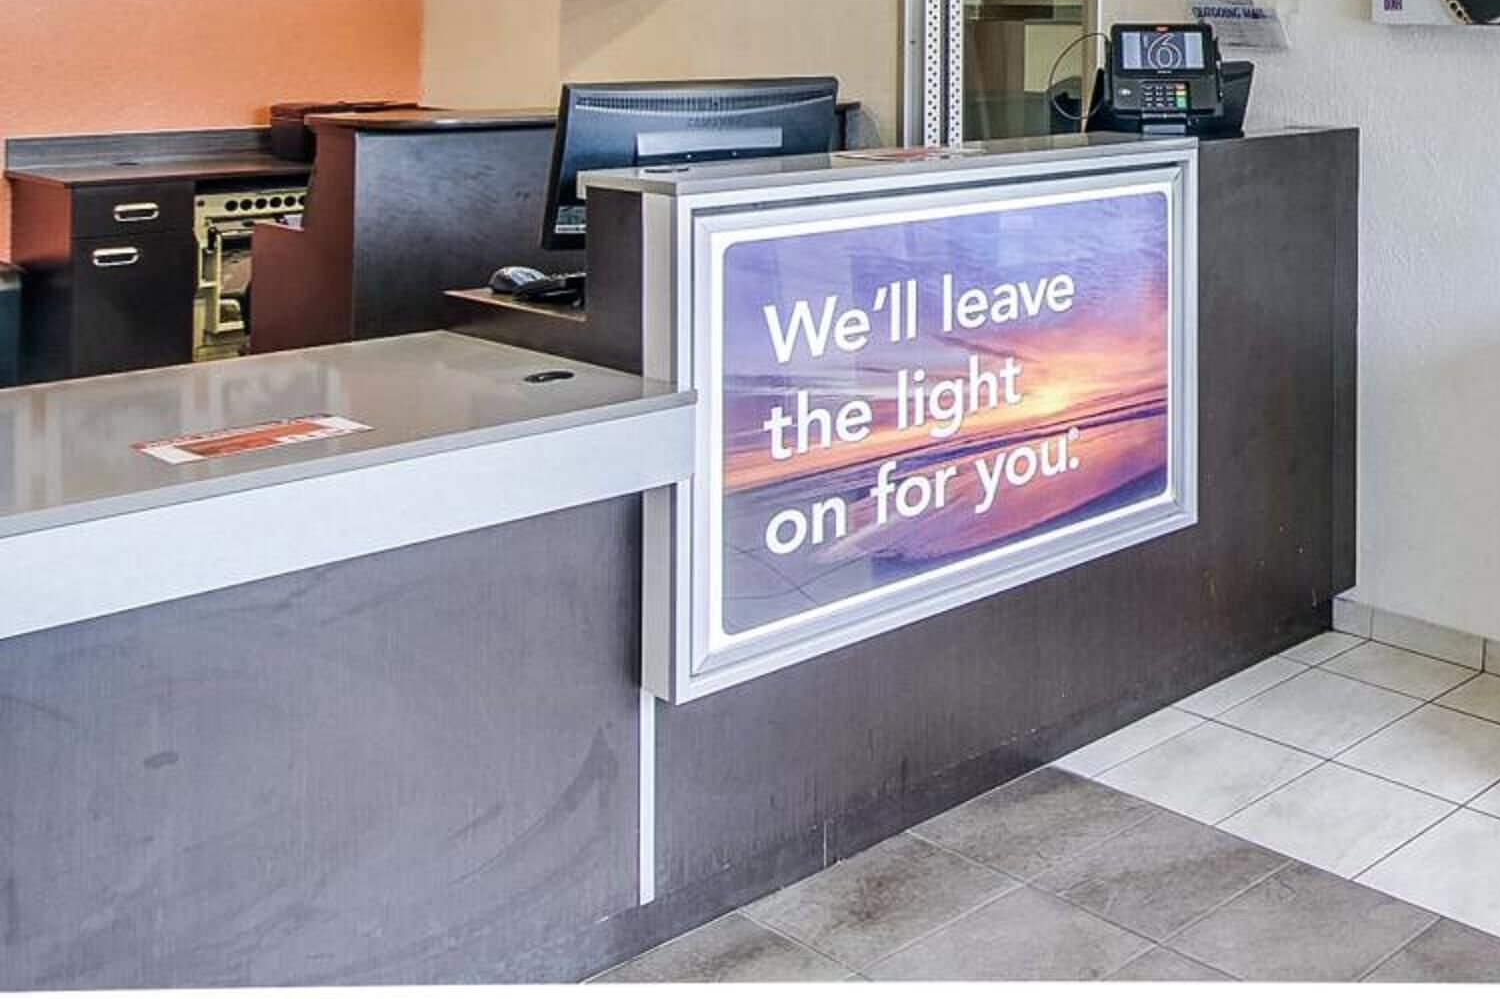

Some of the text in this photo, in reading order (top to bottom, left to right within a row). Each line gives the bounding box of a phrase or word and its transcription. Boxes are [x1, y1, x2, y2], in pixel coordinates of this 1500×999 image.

[763, 273, 1075, 364] We'll leave
[763, 354, 1022, 460] the light
[765, 495, 847, 555] on
[870, 460, 956, 525] for
